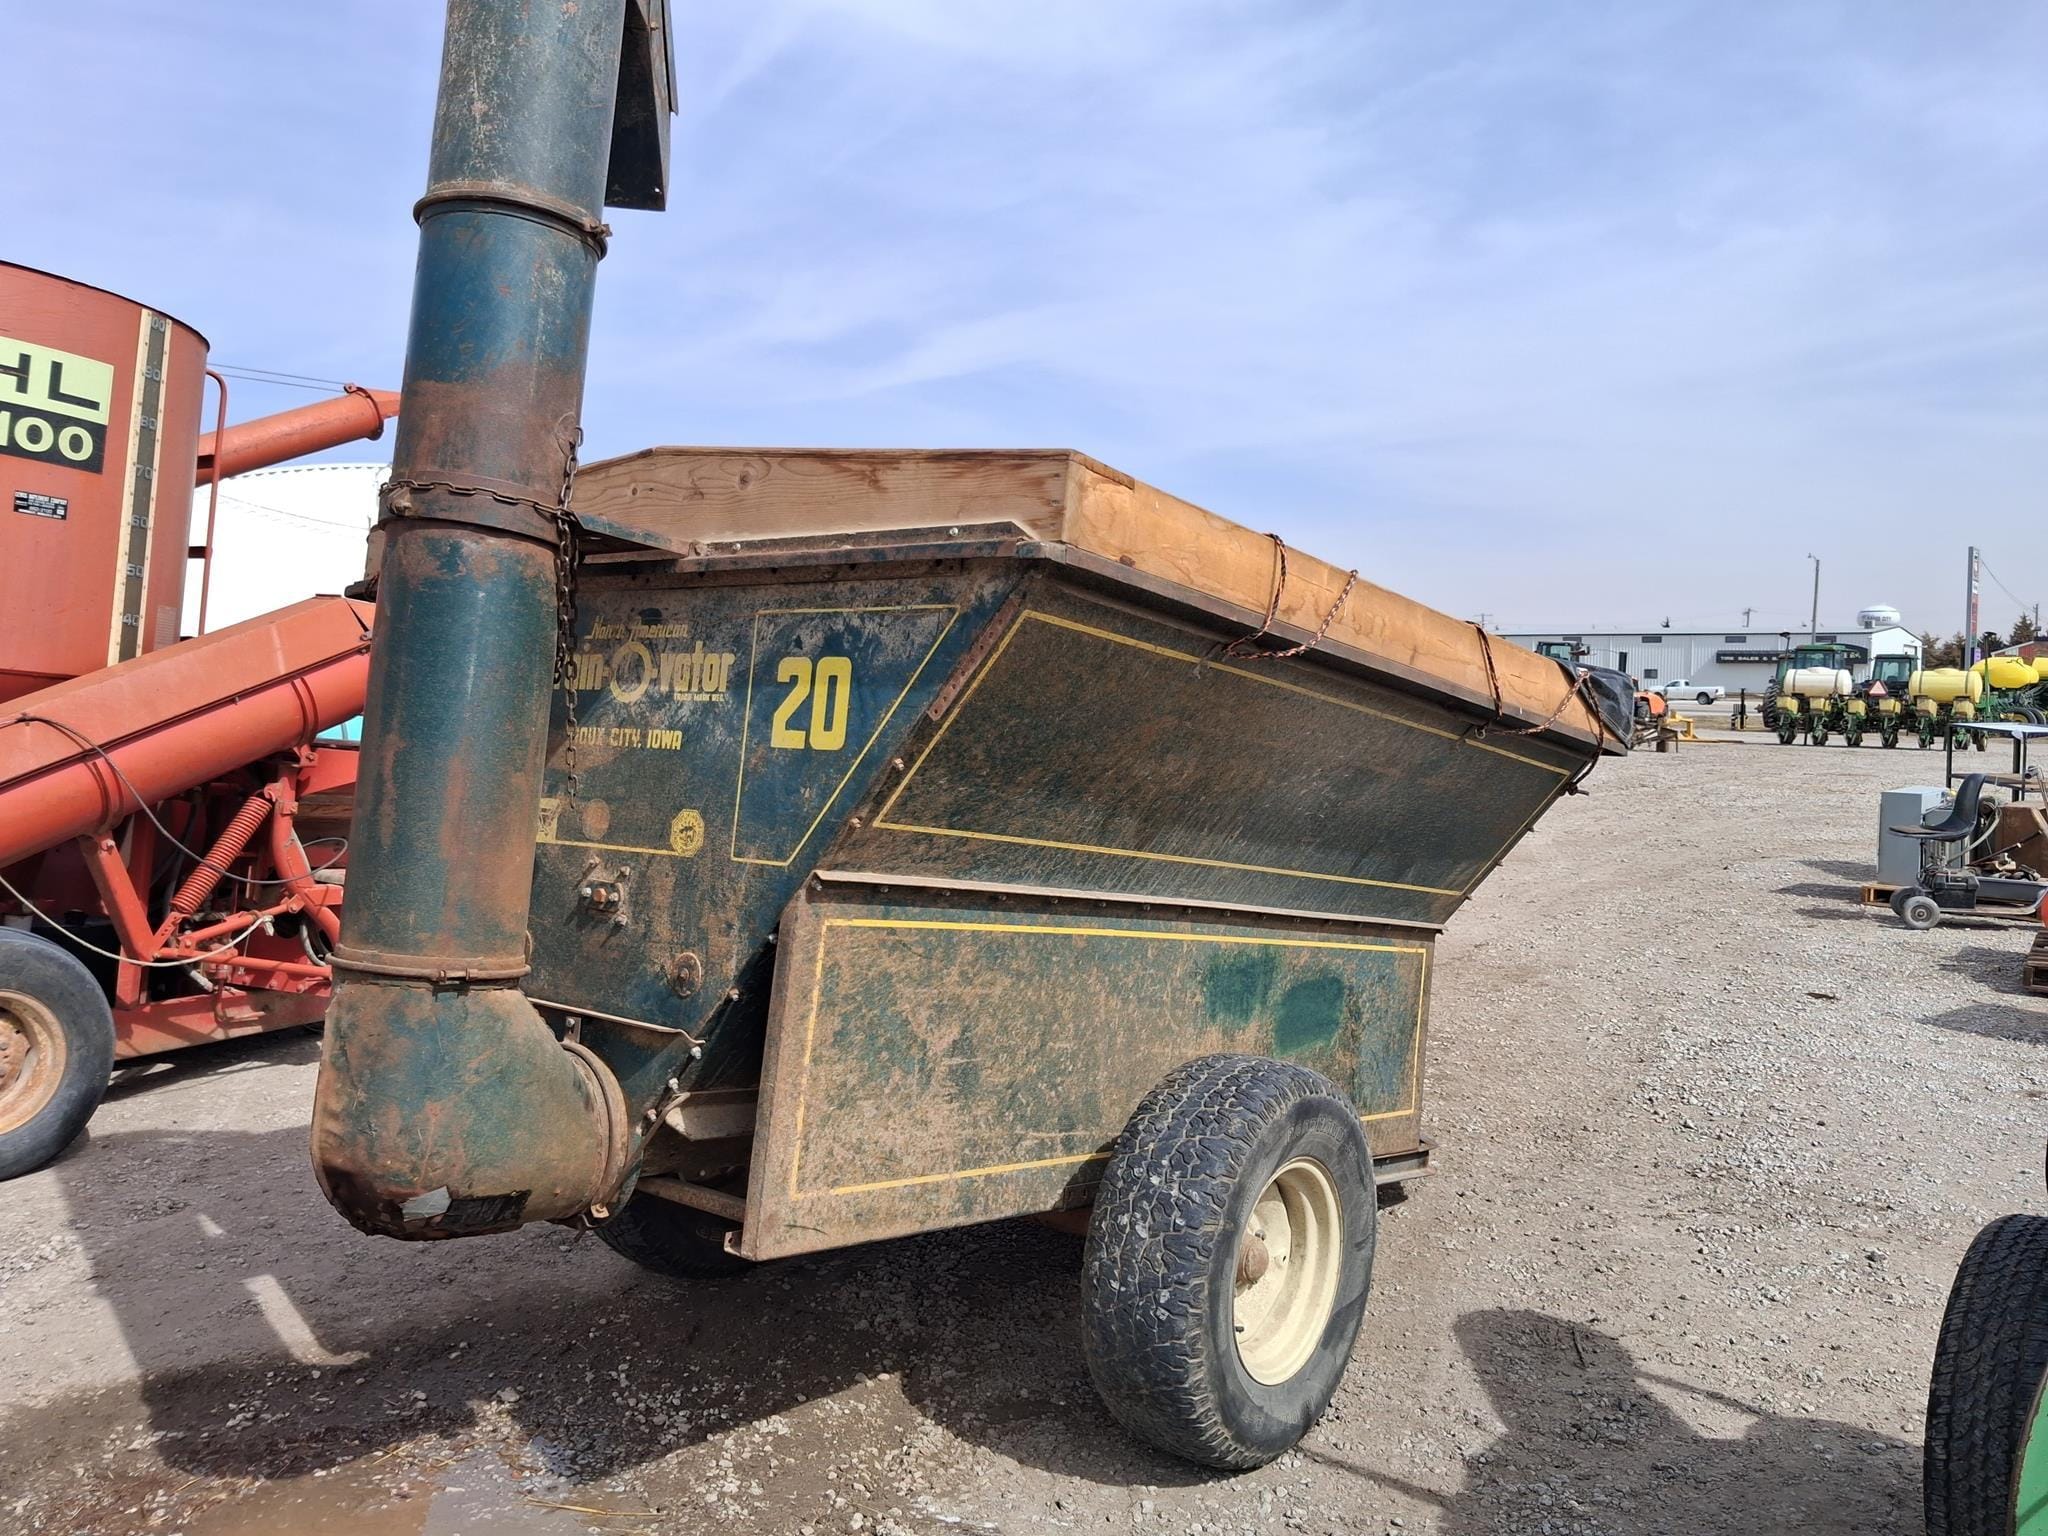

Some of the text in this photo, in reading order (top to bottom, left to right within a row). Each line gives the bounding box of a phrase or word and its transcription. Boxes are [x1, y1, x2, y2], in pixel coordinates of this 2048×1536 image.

[136, 465, 152, 480] 70
[131, 515, 149, 528] 60
[127, 565, 144, 577] 50
[122, 613, 139, 626] 40
[770, 656, 852, 750] 20
[574, 727, 605, 745] IOUX
[647, 729, 682, 750] IOWA
